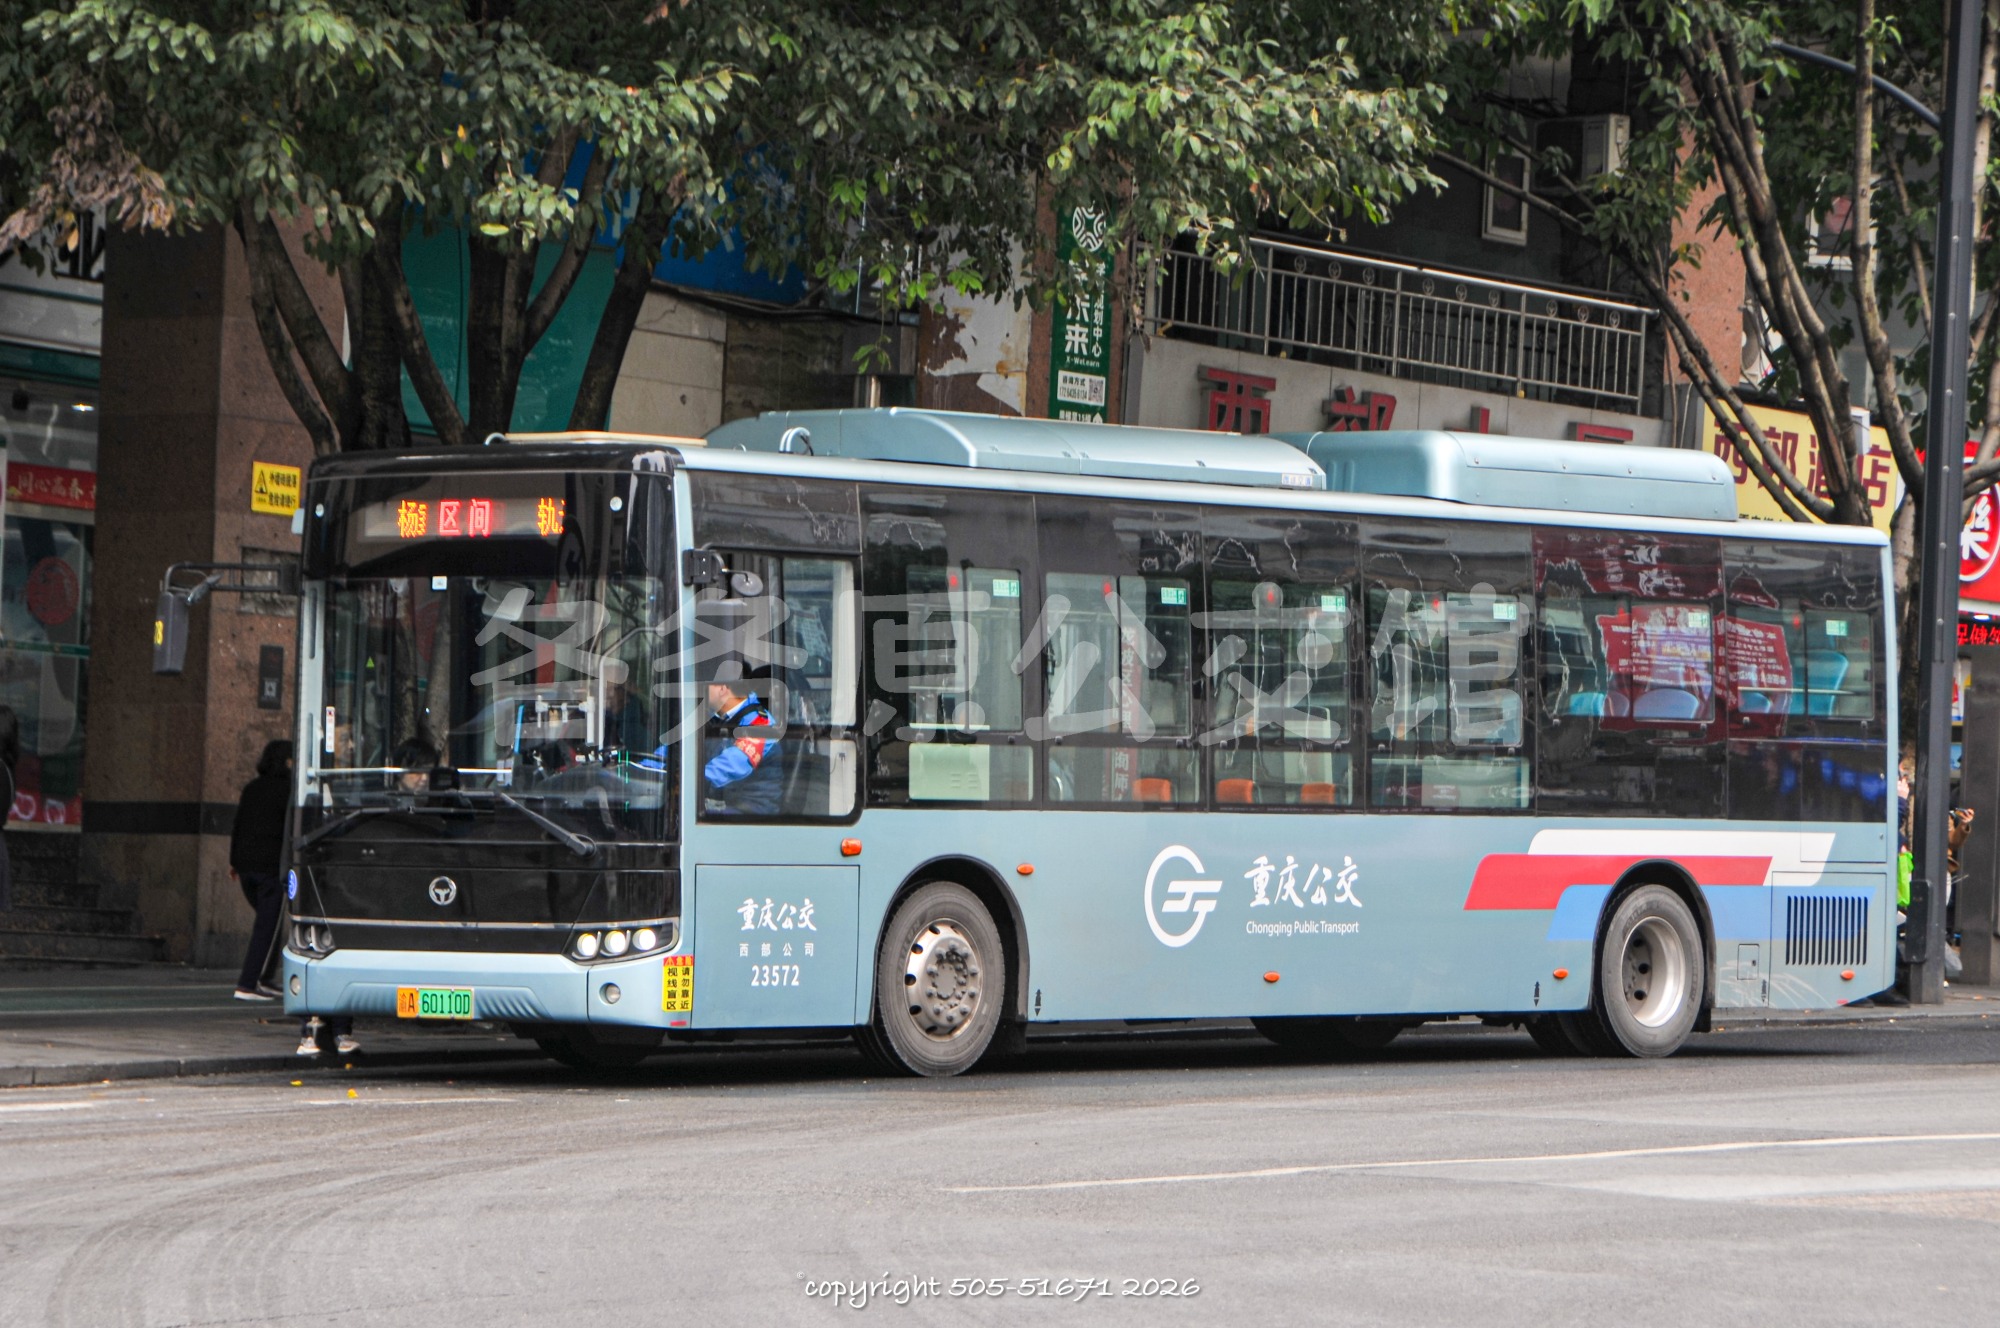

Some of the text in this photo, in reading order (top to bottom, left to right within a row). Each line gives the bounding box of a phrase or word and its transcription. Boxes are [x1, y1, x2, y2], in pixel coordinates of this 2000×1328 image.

[439, 498, 492, 537] 区间
[1243, 855, 1363, 908] 重庆公交
[737, 898, 817, 931] 重庆公交
[1246, 920, 1360, 937] Chongqing Public Transport
[739, 942, 814, 957] 西部公司
[680, 967, 690, 1010] 请勿靠近
[751, 964, 800, 987] 23572
